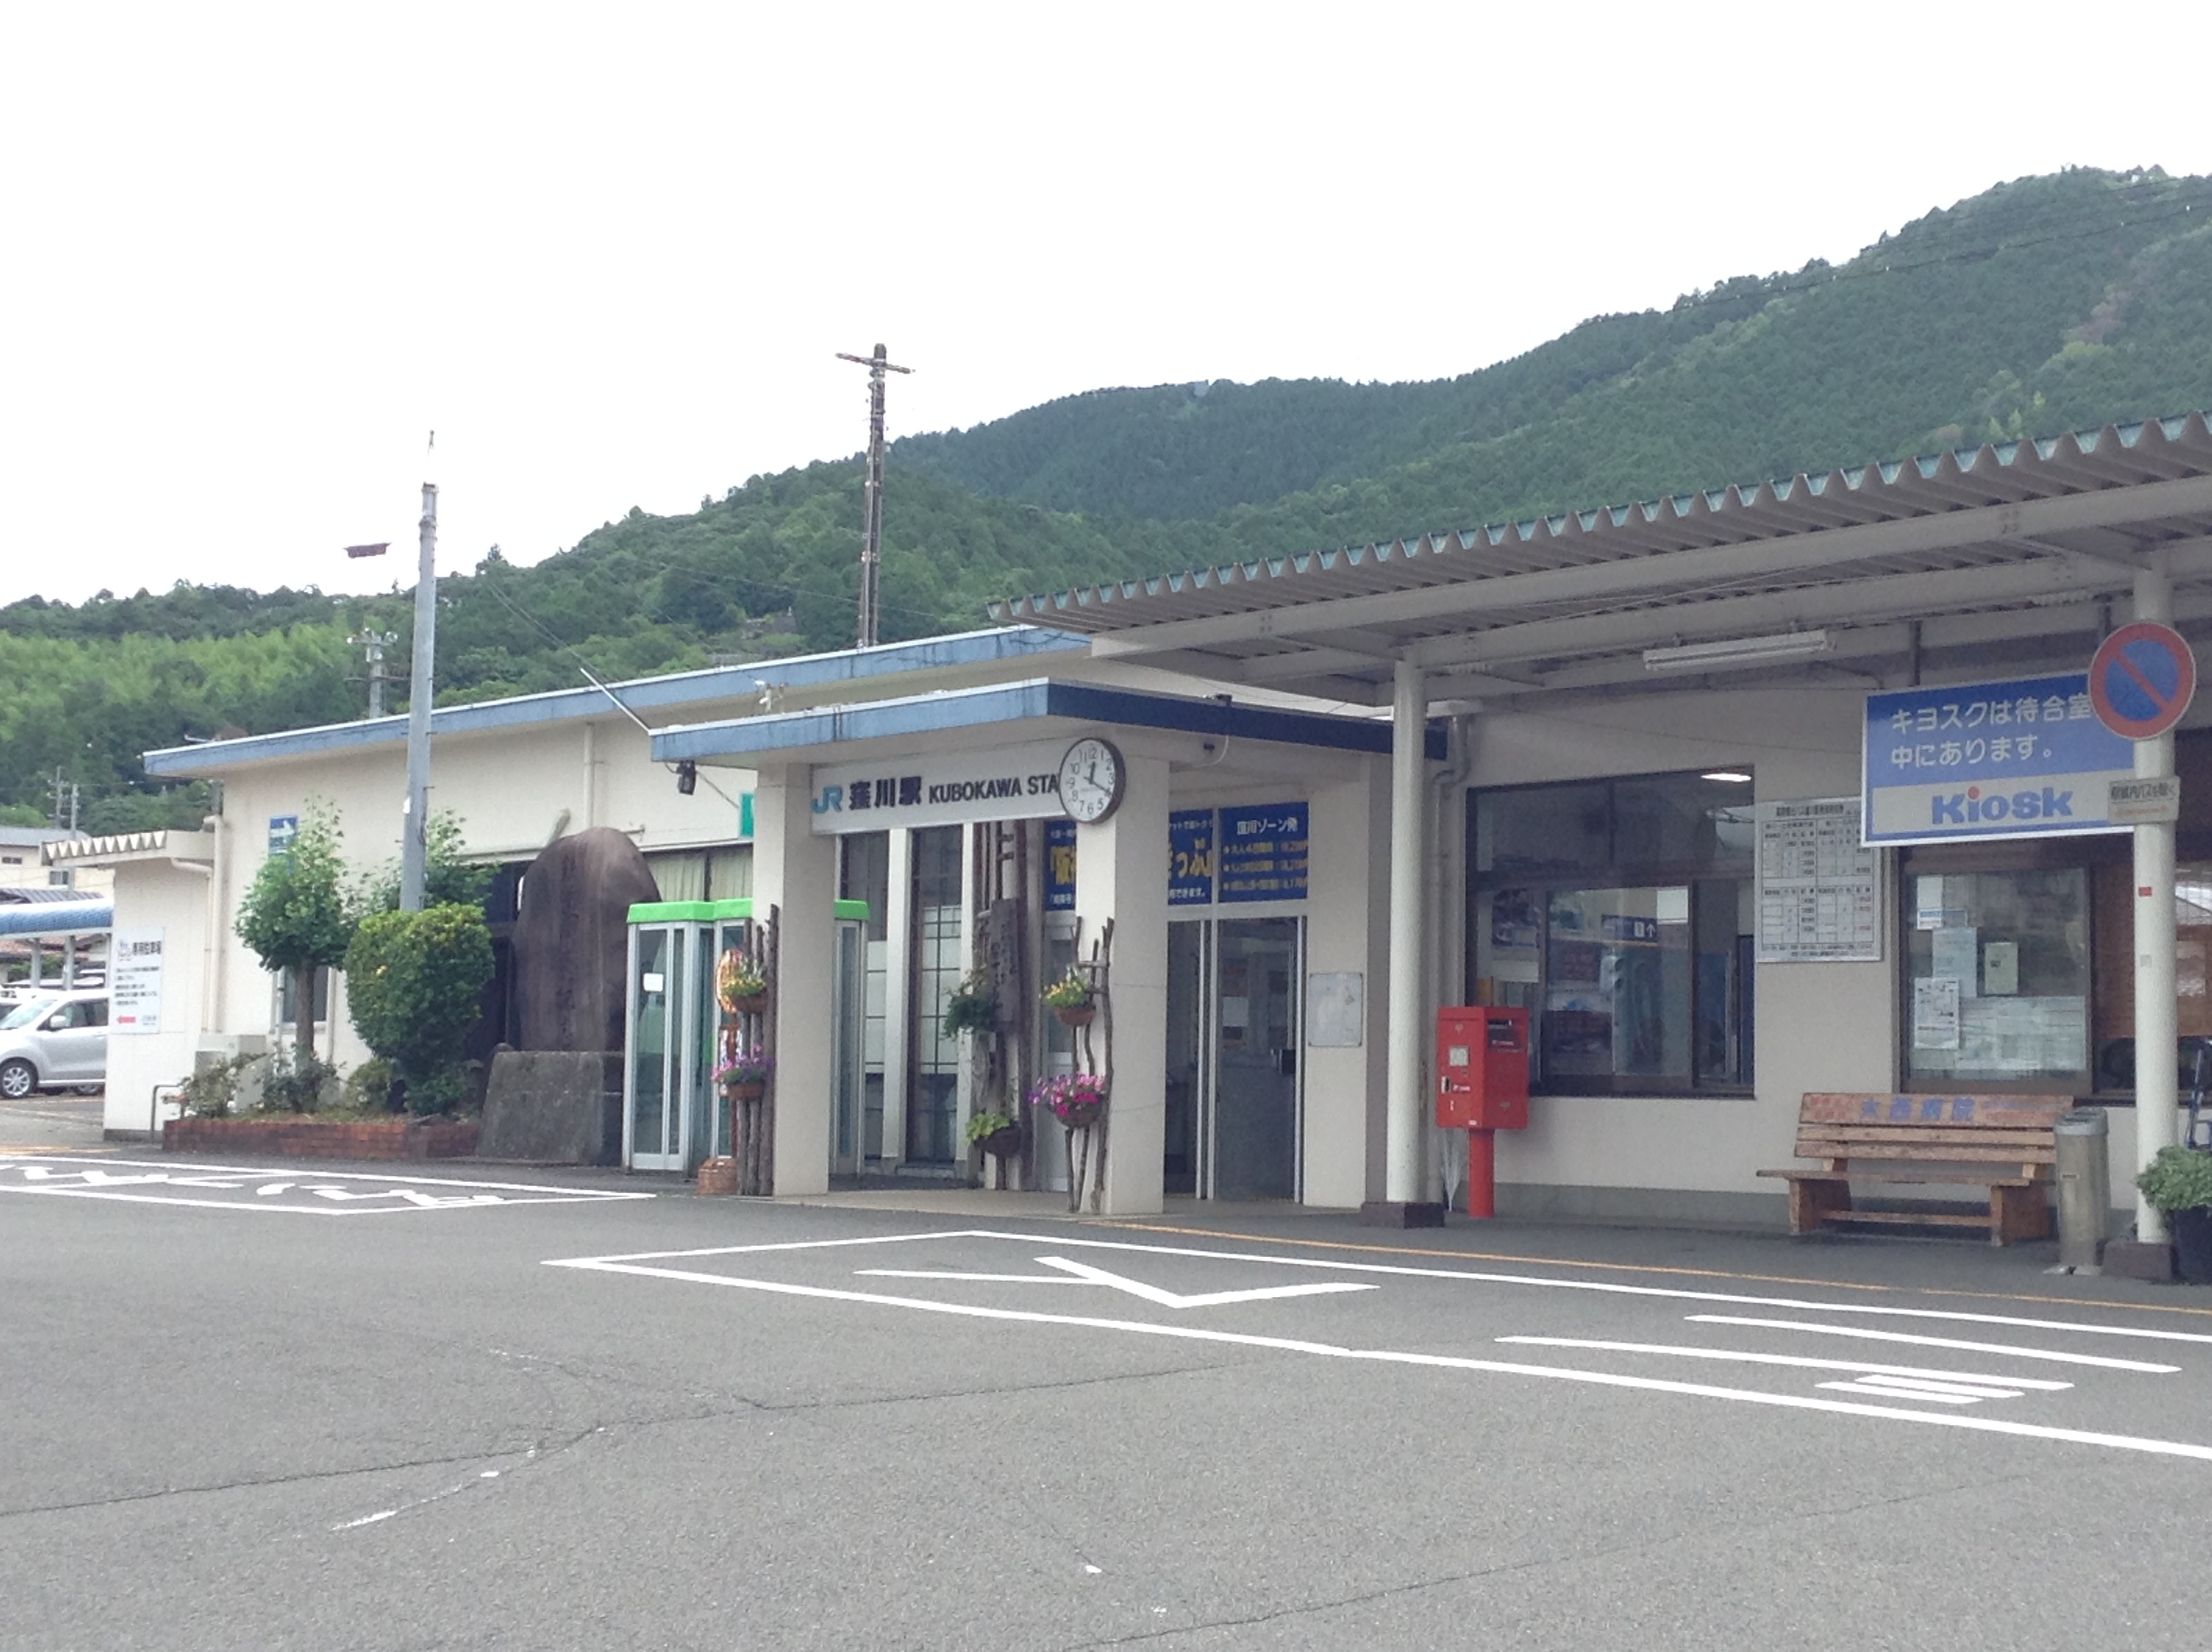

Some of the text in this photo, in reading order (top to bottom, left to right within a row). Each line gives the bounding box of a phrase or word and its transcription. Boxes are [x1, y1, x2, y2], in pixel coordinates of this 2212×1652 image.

[1890, 692, 2093, 735] キヨスクは待合室
[1890, 734, 2052, 770] 中にあります。
[812, 774, 1059, 813] JR 窪川駅 KUBOKAWA STA
[1931, 786, 2074, 825] Kiosk
